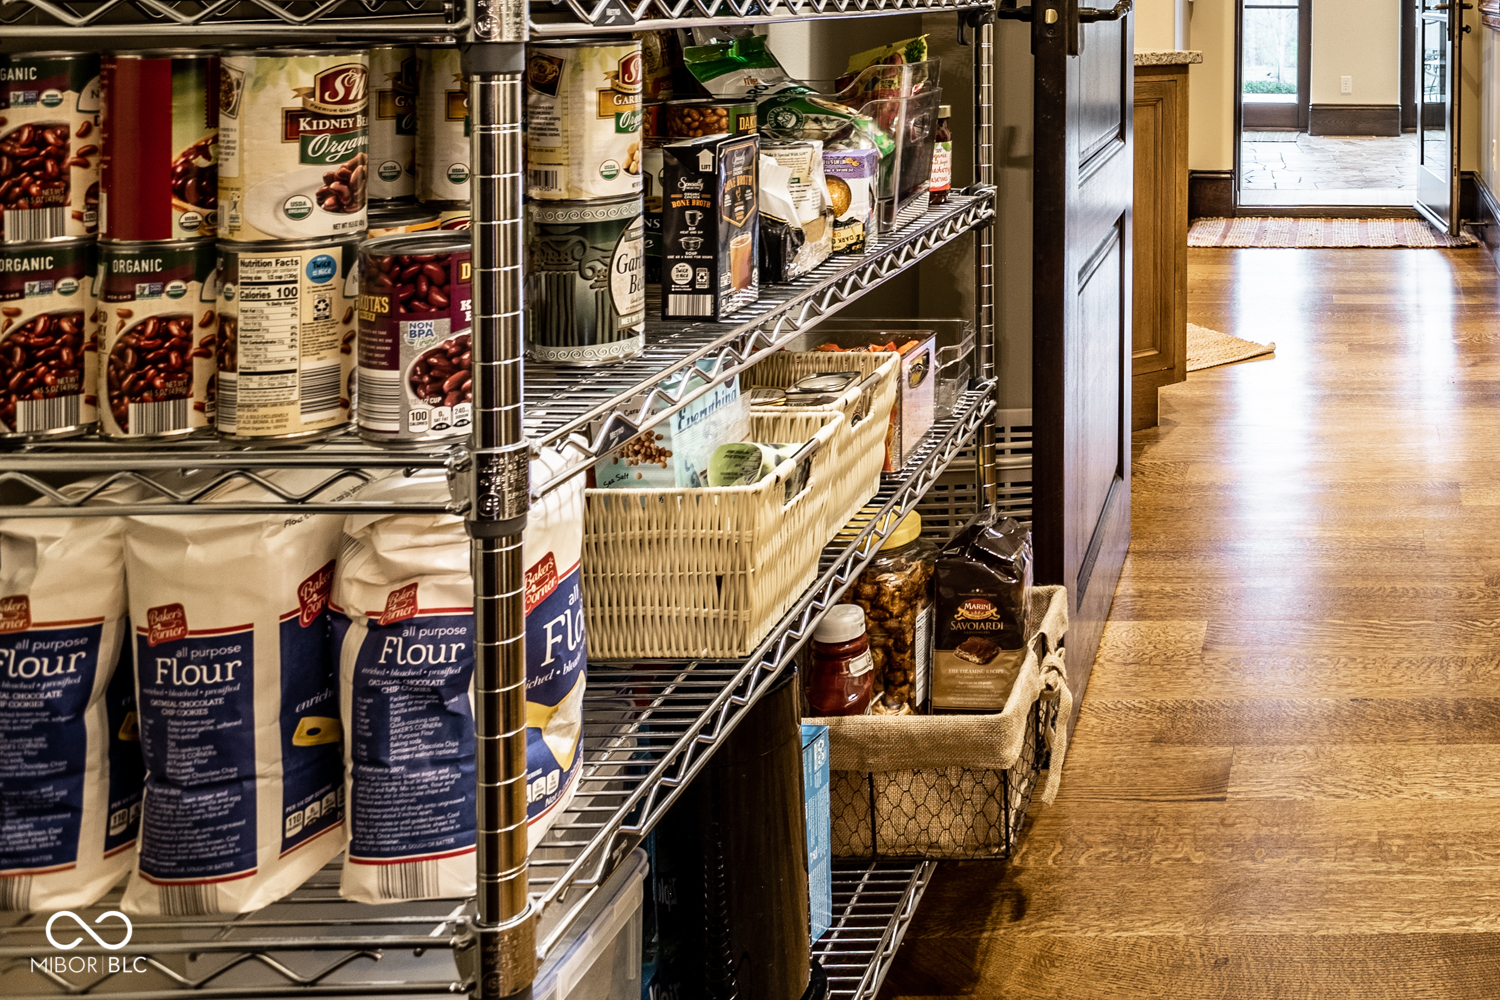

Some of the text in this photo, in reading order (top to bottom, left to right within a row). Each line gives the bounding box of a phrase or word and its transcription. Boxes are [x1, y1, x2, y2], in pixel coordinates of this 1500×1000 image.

[0, 67, 38, 81] GANIC
[310, 103, 338, 113] PREMIUM
[299, 117, 355, 131] KIDNEY
[308, 133, 369, 163] Organi
[678, 176, 704, 192] Specially
[671, 199, 712, 209] BONE BROTH
[838, 234, 854, 243] DARK
[112, 258, 163, 273] ORGANIC
[240, 258, 299, 268] Nutrition Facts
[240, 286, 298, 299] Calories 100
[409, 322, 433, 330] NON
[409, 328, 434, 338] BPA
[430, 396, 442, 404] CUP
[411, 411, 428, 421] 100
[603, 472, 630, 488] Sea Salt
[525, 558, 554, 589] Baker's
[388, 587, 416, 607] Baker's
[525, 576, 556, 613] Corner
[568, 584, 580, 606] all
[964, 602, 992, 611] MARINI
[149, 608, 183, 626] Baker's
[380, 605, 414, 625] Corner
[950, 620, 1004, 631] SAVOIARDI
[150, 626, 185, 644] Corner
[402, 626, 468, 640] all purpose
[540, 608, 584, 668] Flo
[15, 636, 88, 654] all purpose
[176, 645, 242, 660] all purpose
[378, 636, 466, 666] Flour
[155, 657, 243, 686] Flour
[390, 668, 422, 676] bleached
[428, 666, 462, 678] presifted
[402, 678, 446, 687] CHOCOLATE
[525, 668, 554, 690] iched
[168, 682, 241, 698] bleached presifted
[381, 684, 400, 694] CHIP
[12, 690, 63, 700] CHOCOLATE
[390, 694, 410, 702] Packed
[8, 700, 44, 708] COOKIES
[178, 697, 225, 708] CHOCOLATE
[295, 688, 335, 714] enrich
[176, 708, 209, 716] COOKIES
[390, 708, 408, 716] Vanilla
[390, 726, 414, 736] BAKER'S
[390, 734, 398, 742] All
[398, 732, 420, 740] Purpose
[390, 740, 408, 748] Baking
[418, 742, 444, 751] Chocolate
[444, 740, 459, 748] Chips
[390, 747, 458, 762] Chopped walnuts (optional)
[450, 772, 462, 780] egg
[438, 796, 466, 807] ungreased
[112, 811, 126, 822] 110
[446, 810, 460, 819] Cool
[288, 815, 301, 827] 110
